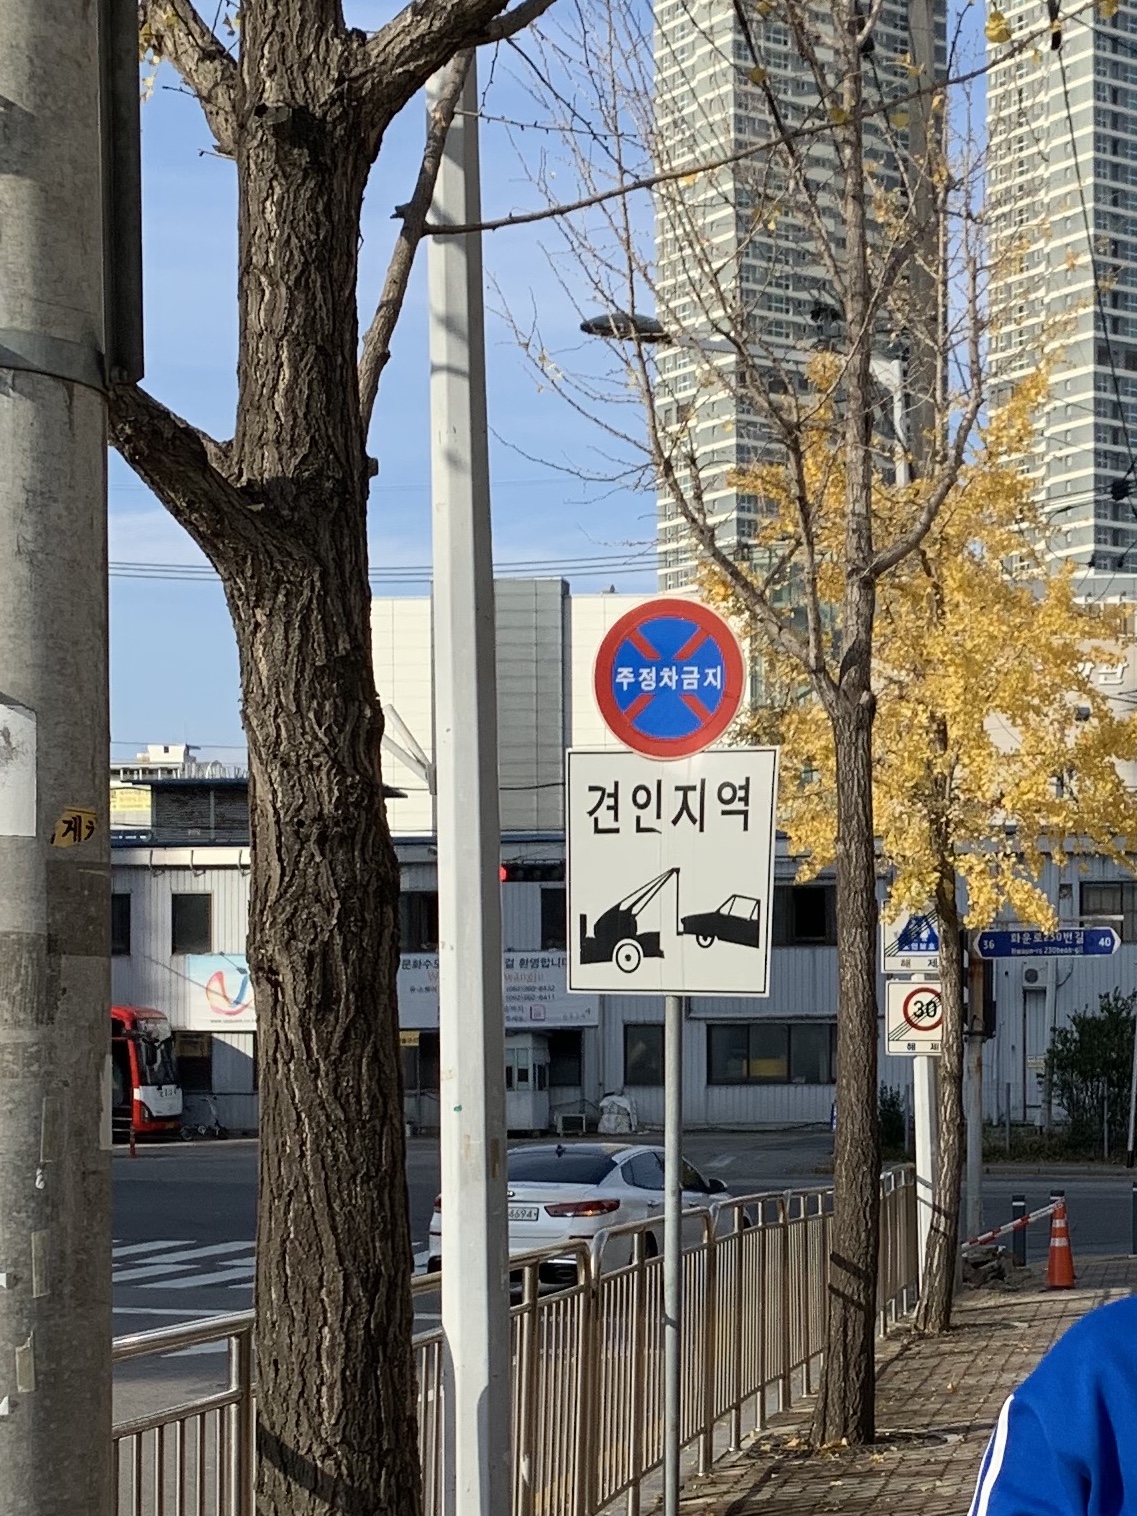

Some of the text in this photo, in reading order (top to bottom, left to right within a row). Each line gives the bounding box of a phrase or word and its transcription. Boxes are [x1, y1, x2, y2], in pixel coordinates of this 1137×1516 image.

[615, 665, 723, 691] 주정차금지
[586, 775, 752, 835] 견인지역
[982, 940, 995, 950] 36
[1098, 937, 1112, 947] 40
[913, 1000, 937, 1018] 30
